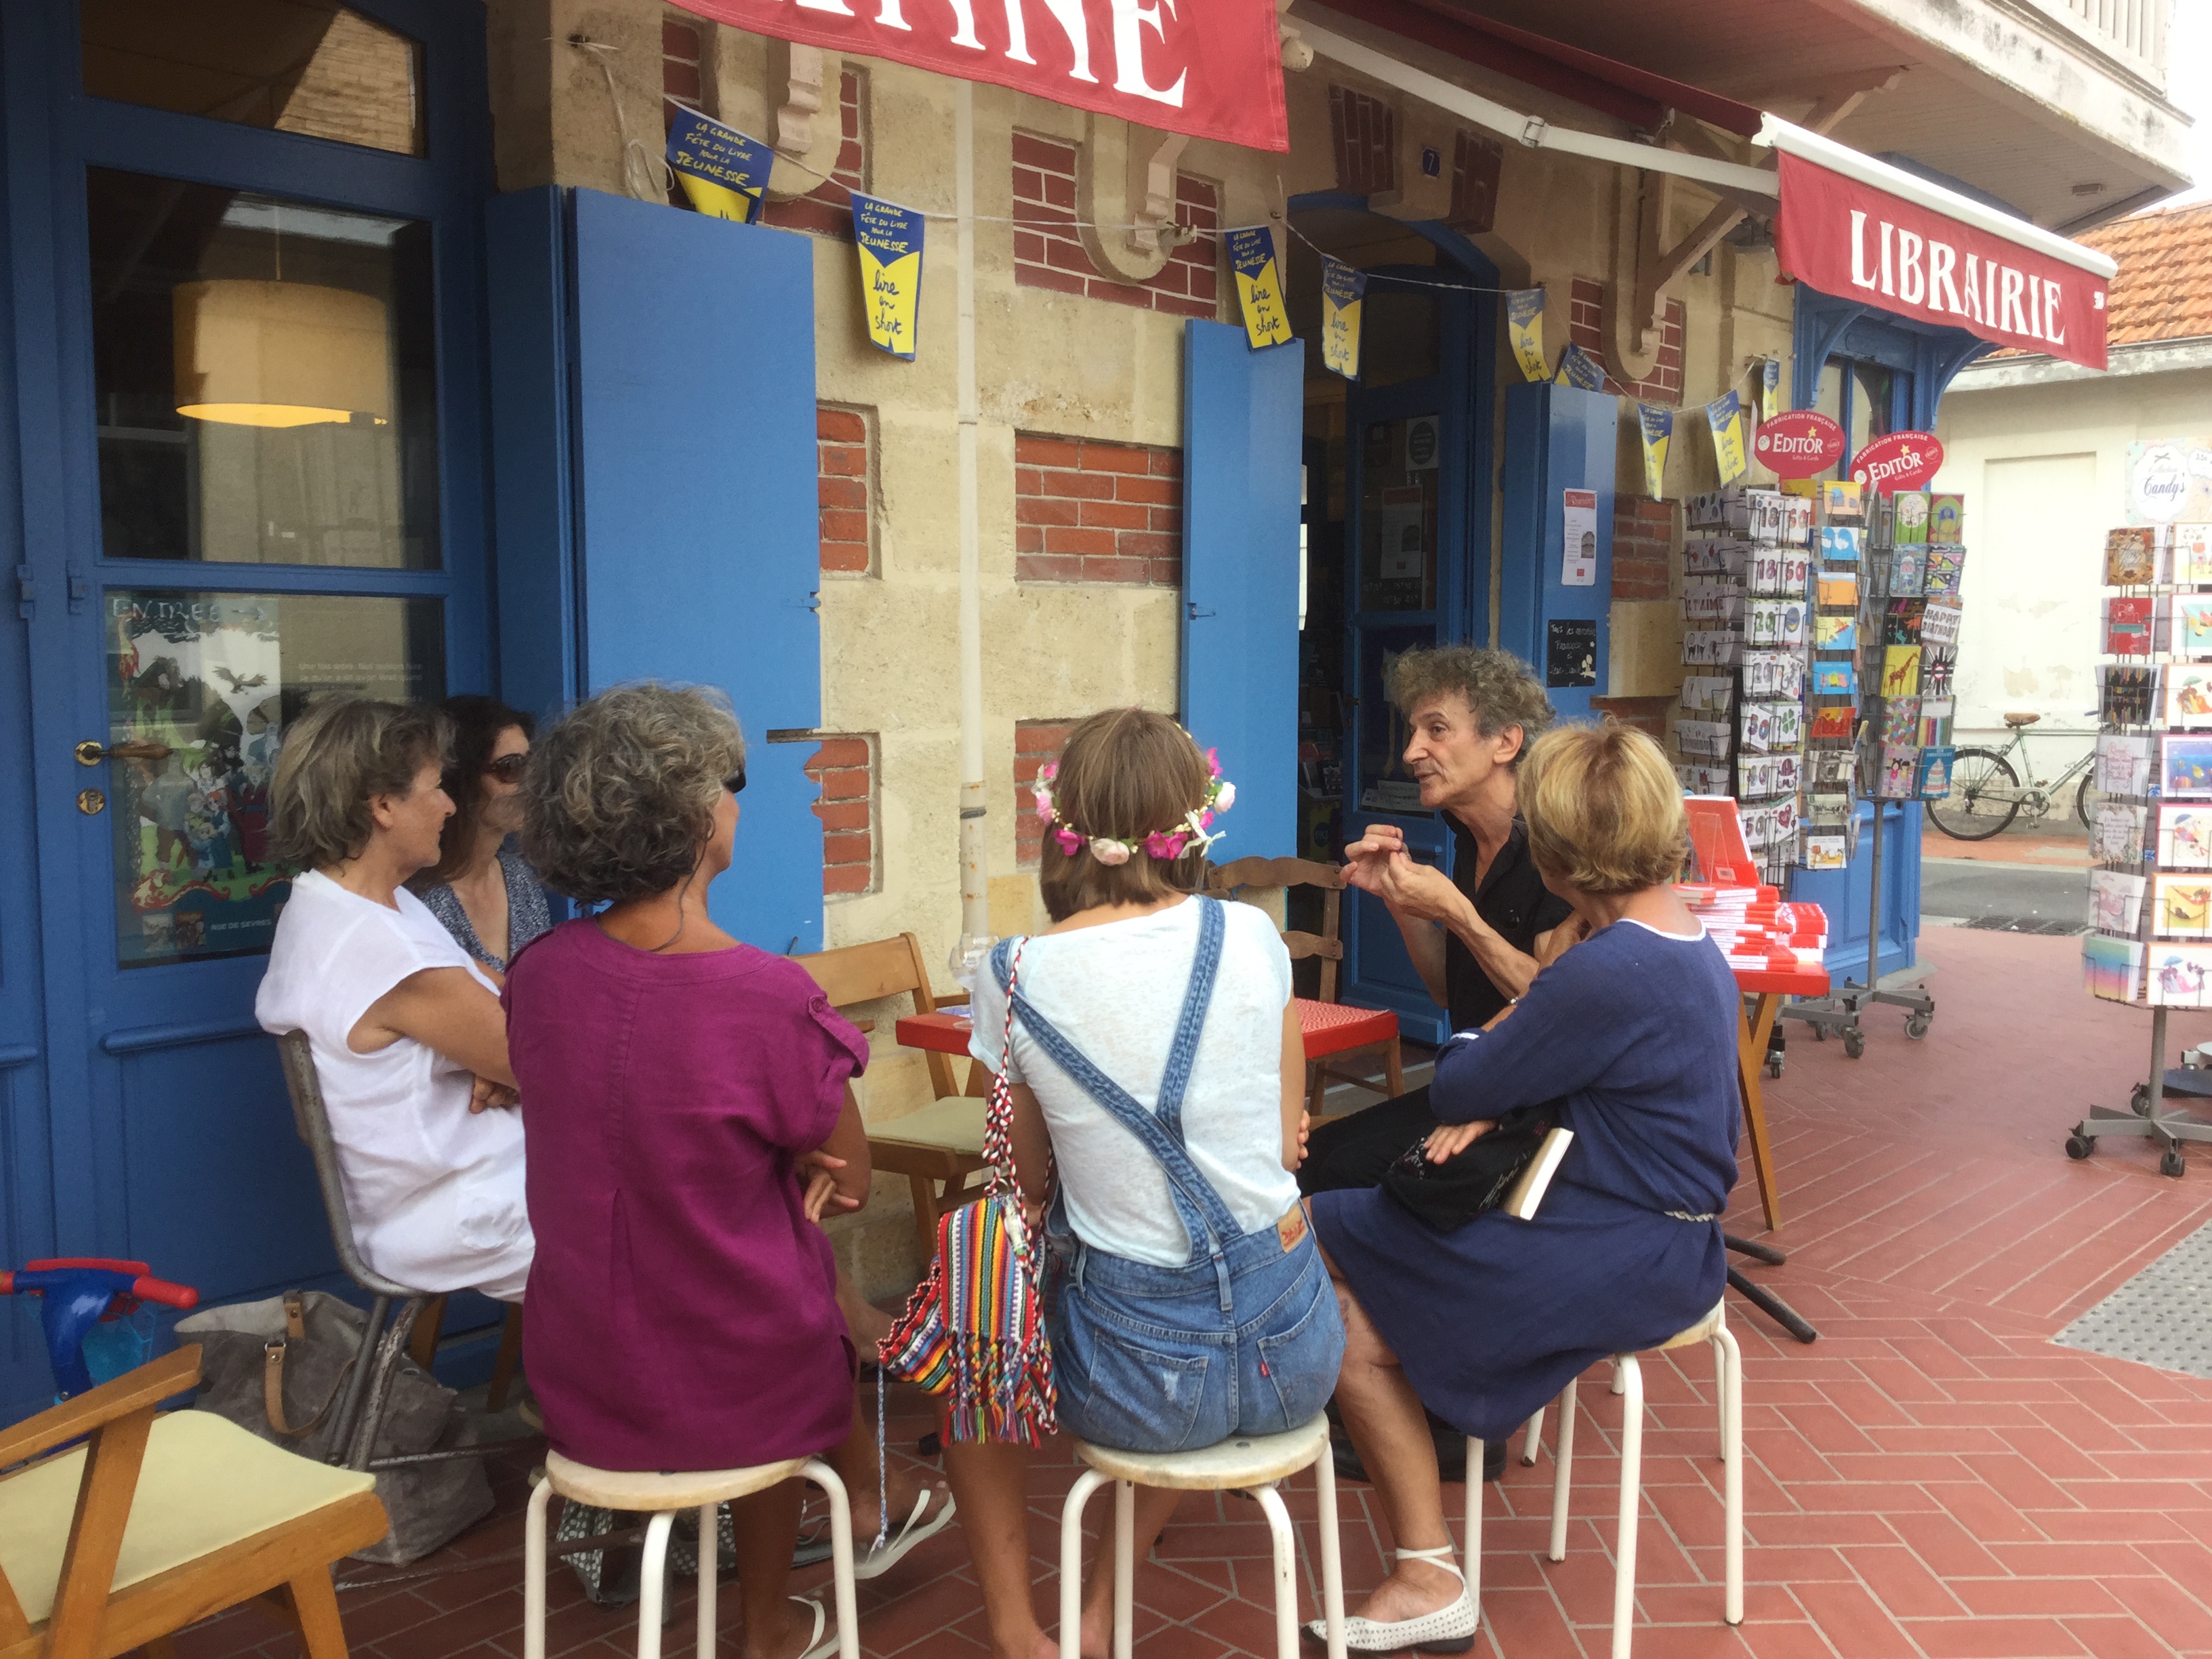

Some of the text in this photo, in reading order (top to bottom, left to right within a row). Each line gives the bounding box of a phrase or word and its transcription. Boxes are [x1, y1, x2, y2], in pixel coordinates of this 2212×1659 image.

[695, 122, 745, 146] LA GRANDE
[685, 133, 752, 161] FÊTE DU LIVRE
[676, 151, 750, 186] JEUNESSE
[864, 203, 903, 217] LA GRANDE
[890, 220, 908, 230] LIVRE
[860, 231, 909, 254] JEUNESSE
[873, 269, 900, 295] lire
[1850, 209, 2066, 345] LIBRAIRIE
[879, 295, 895, 310] en
[1250, 284, 1271, 304] lire
[875, 308, 903, 335] short
[1256, 313, 1281, 336] short
[1766, 413, 1837, 432] FABRICATION FRANÇAISE
[1773, 433, 1823, 454] EDITOR
[1856, 433, 1929, 464] FABRICATION FRANÇAISE
[1868, 452, 1924, 481] EDITOR
